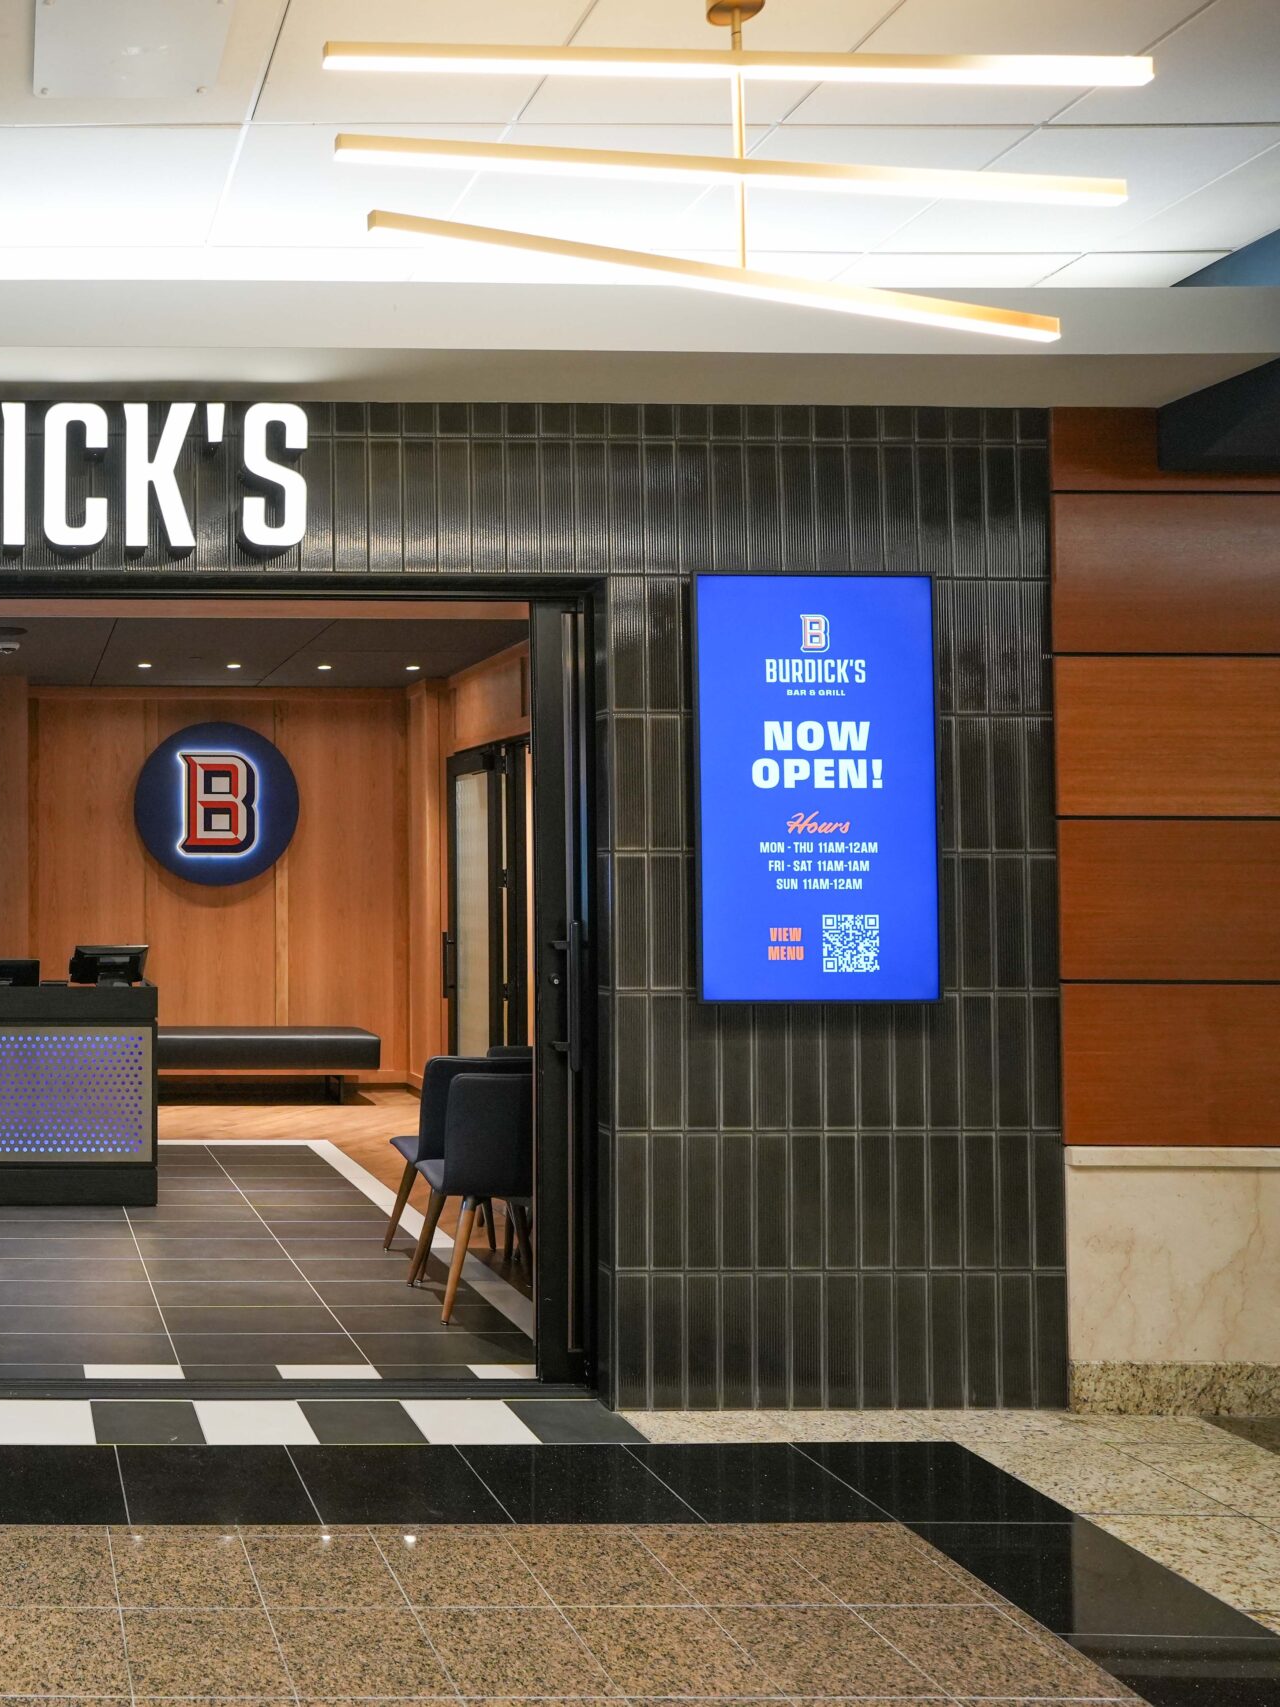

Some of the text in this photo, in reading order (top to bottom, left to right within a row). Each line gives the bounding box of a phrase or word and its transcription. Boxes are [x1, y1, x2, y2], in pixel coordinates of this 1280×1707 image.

[800, 614, 830, 653] B
[765, 658, 866, 684] BURDICK'S
[817, 689, 846, 697] GRILL
[763, 720, 871, 751] NOW
[751, 757, 883, 789] OPEN!
[178, 751, 258, 856] B
[785, 811, 851, 835] Hours
[759, 841, 785, 854] MON
[792, 841, 814, 854] THU
[817, 841, 879, 854] 11AM-12AM
[768, 859, 785, 872] FRI
[793, 859, 813, 872] SAT
[816, 859, 870, 872] 11AM-1AM
[776, 878, 863, 890] SUN 11AM-12AM
[769, 927, 803, 943] VIEW
[767, 945, 805, 961] MENU
